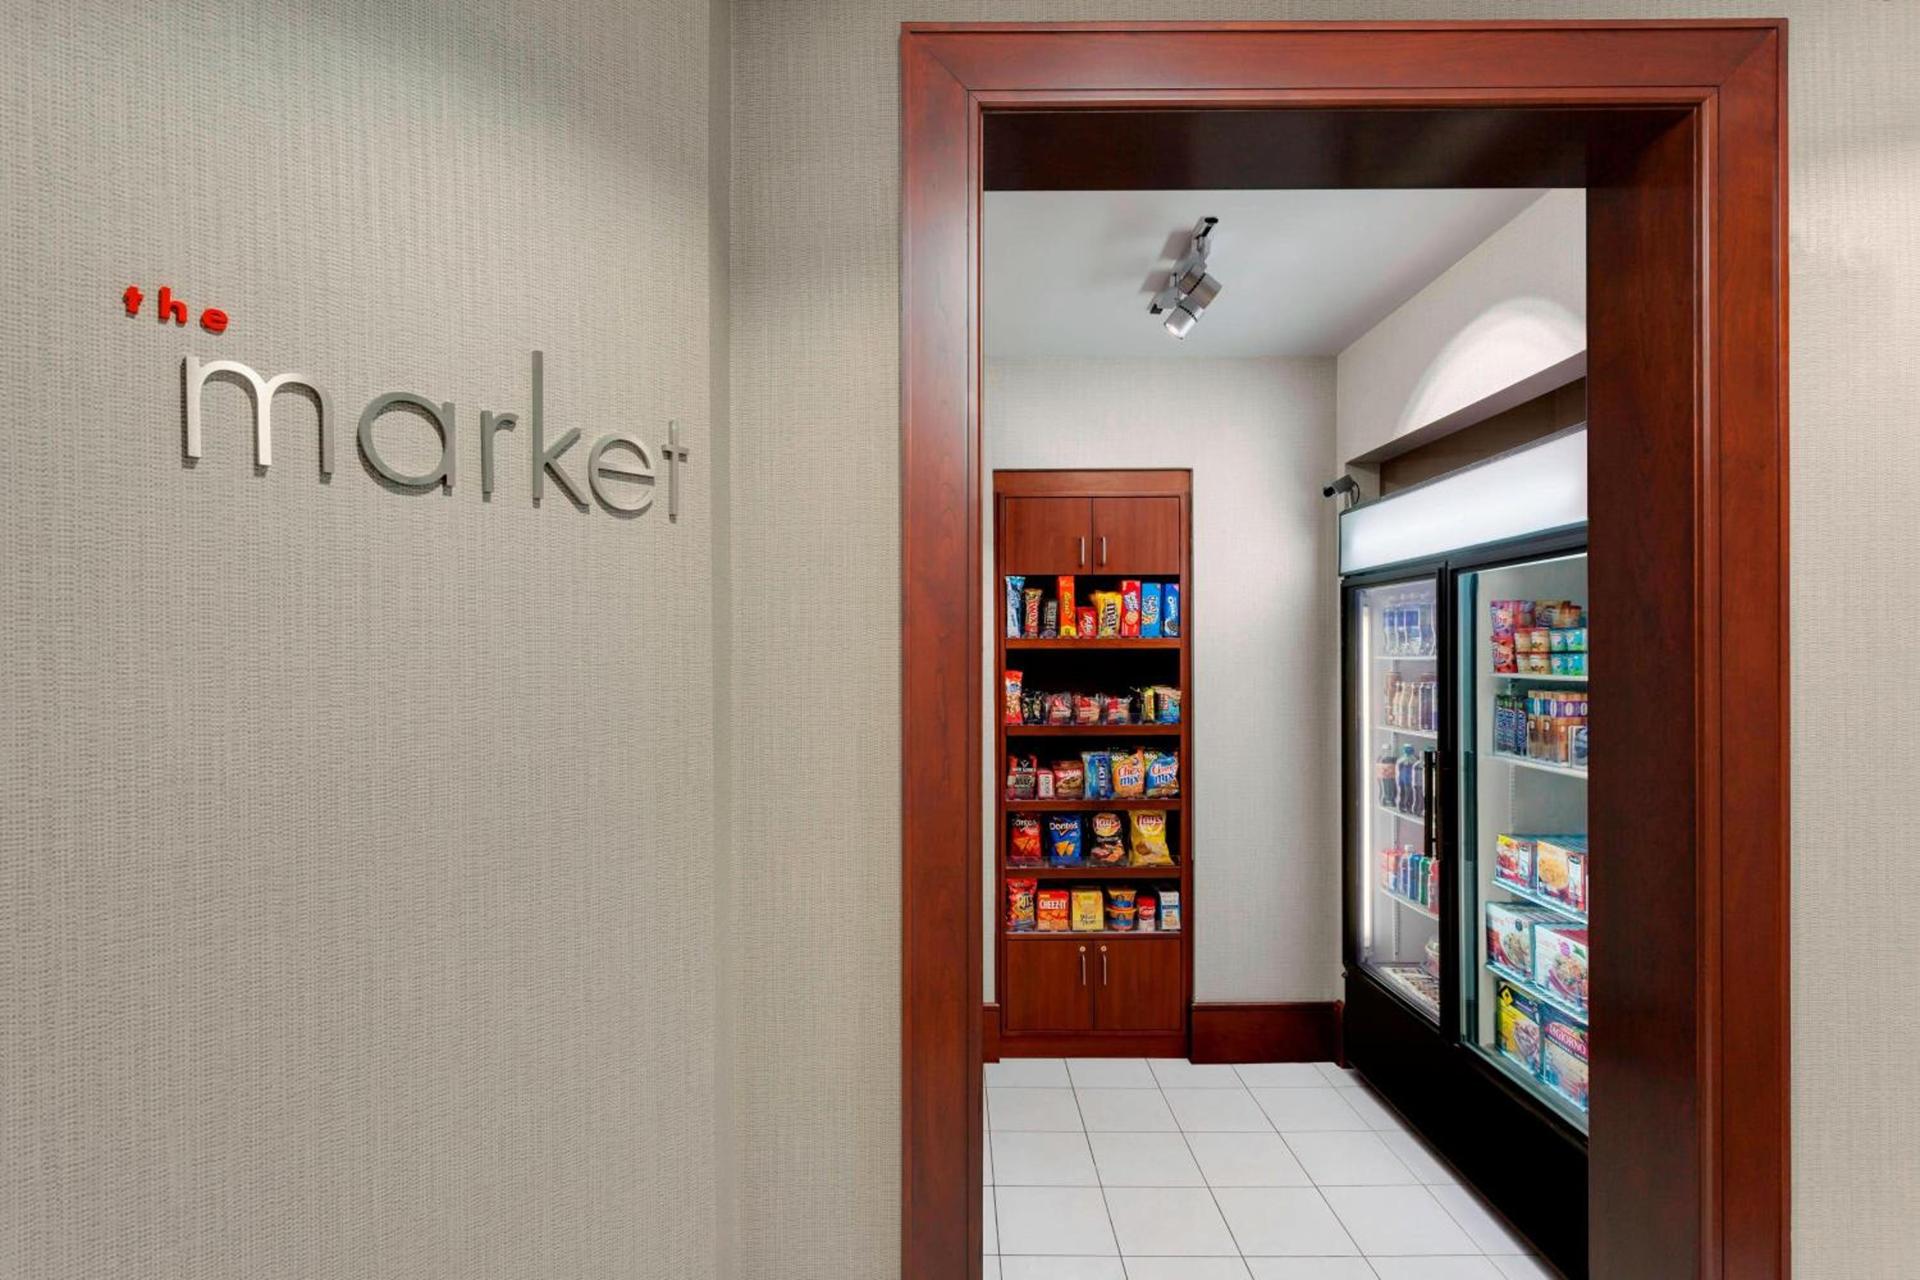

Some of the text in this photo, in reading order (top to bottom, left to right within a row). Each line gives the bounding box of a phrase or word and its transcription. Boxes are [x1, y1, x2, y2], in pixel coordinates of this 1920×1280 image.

[122, 285, 229, 332] the
[182, 350, 689, 521] market
[1049, 821, 1078, 831] Doritos
